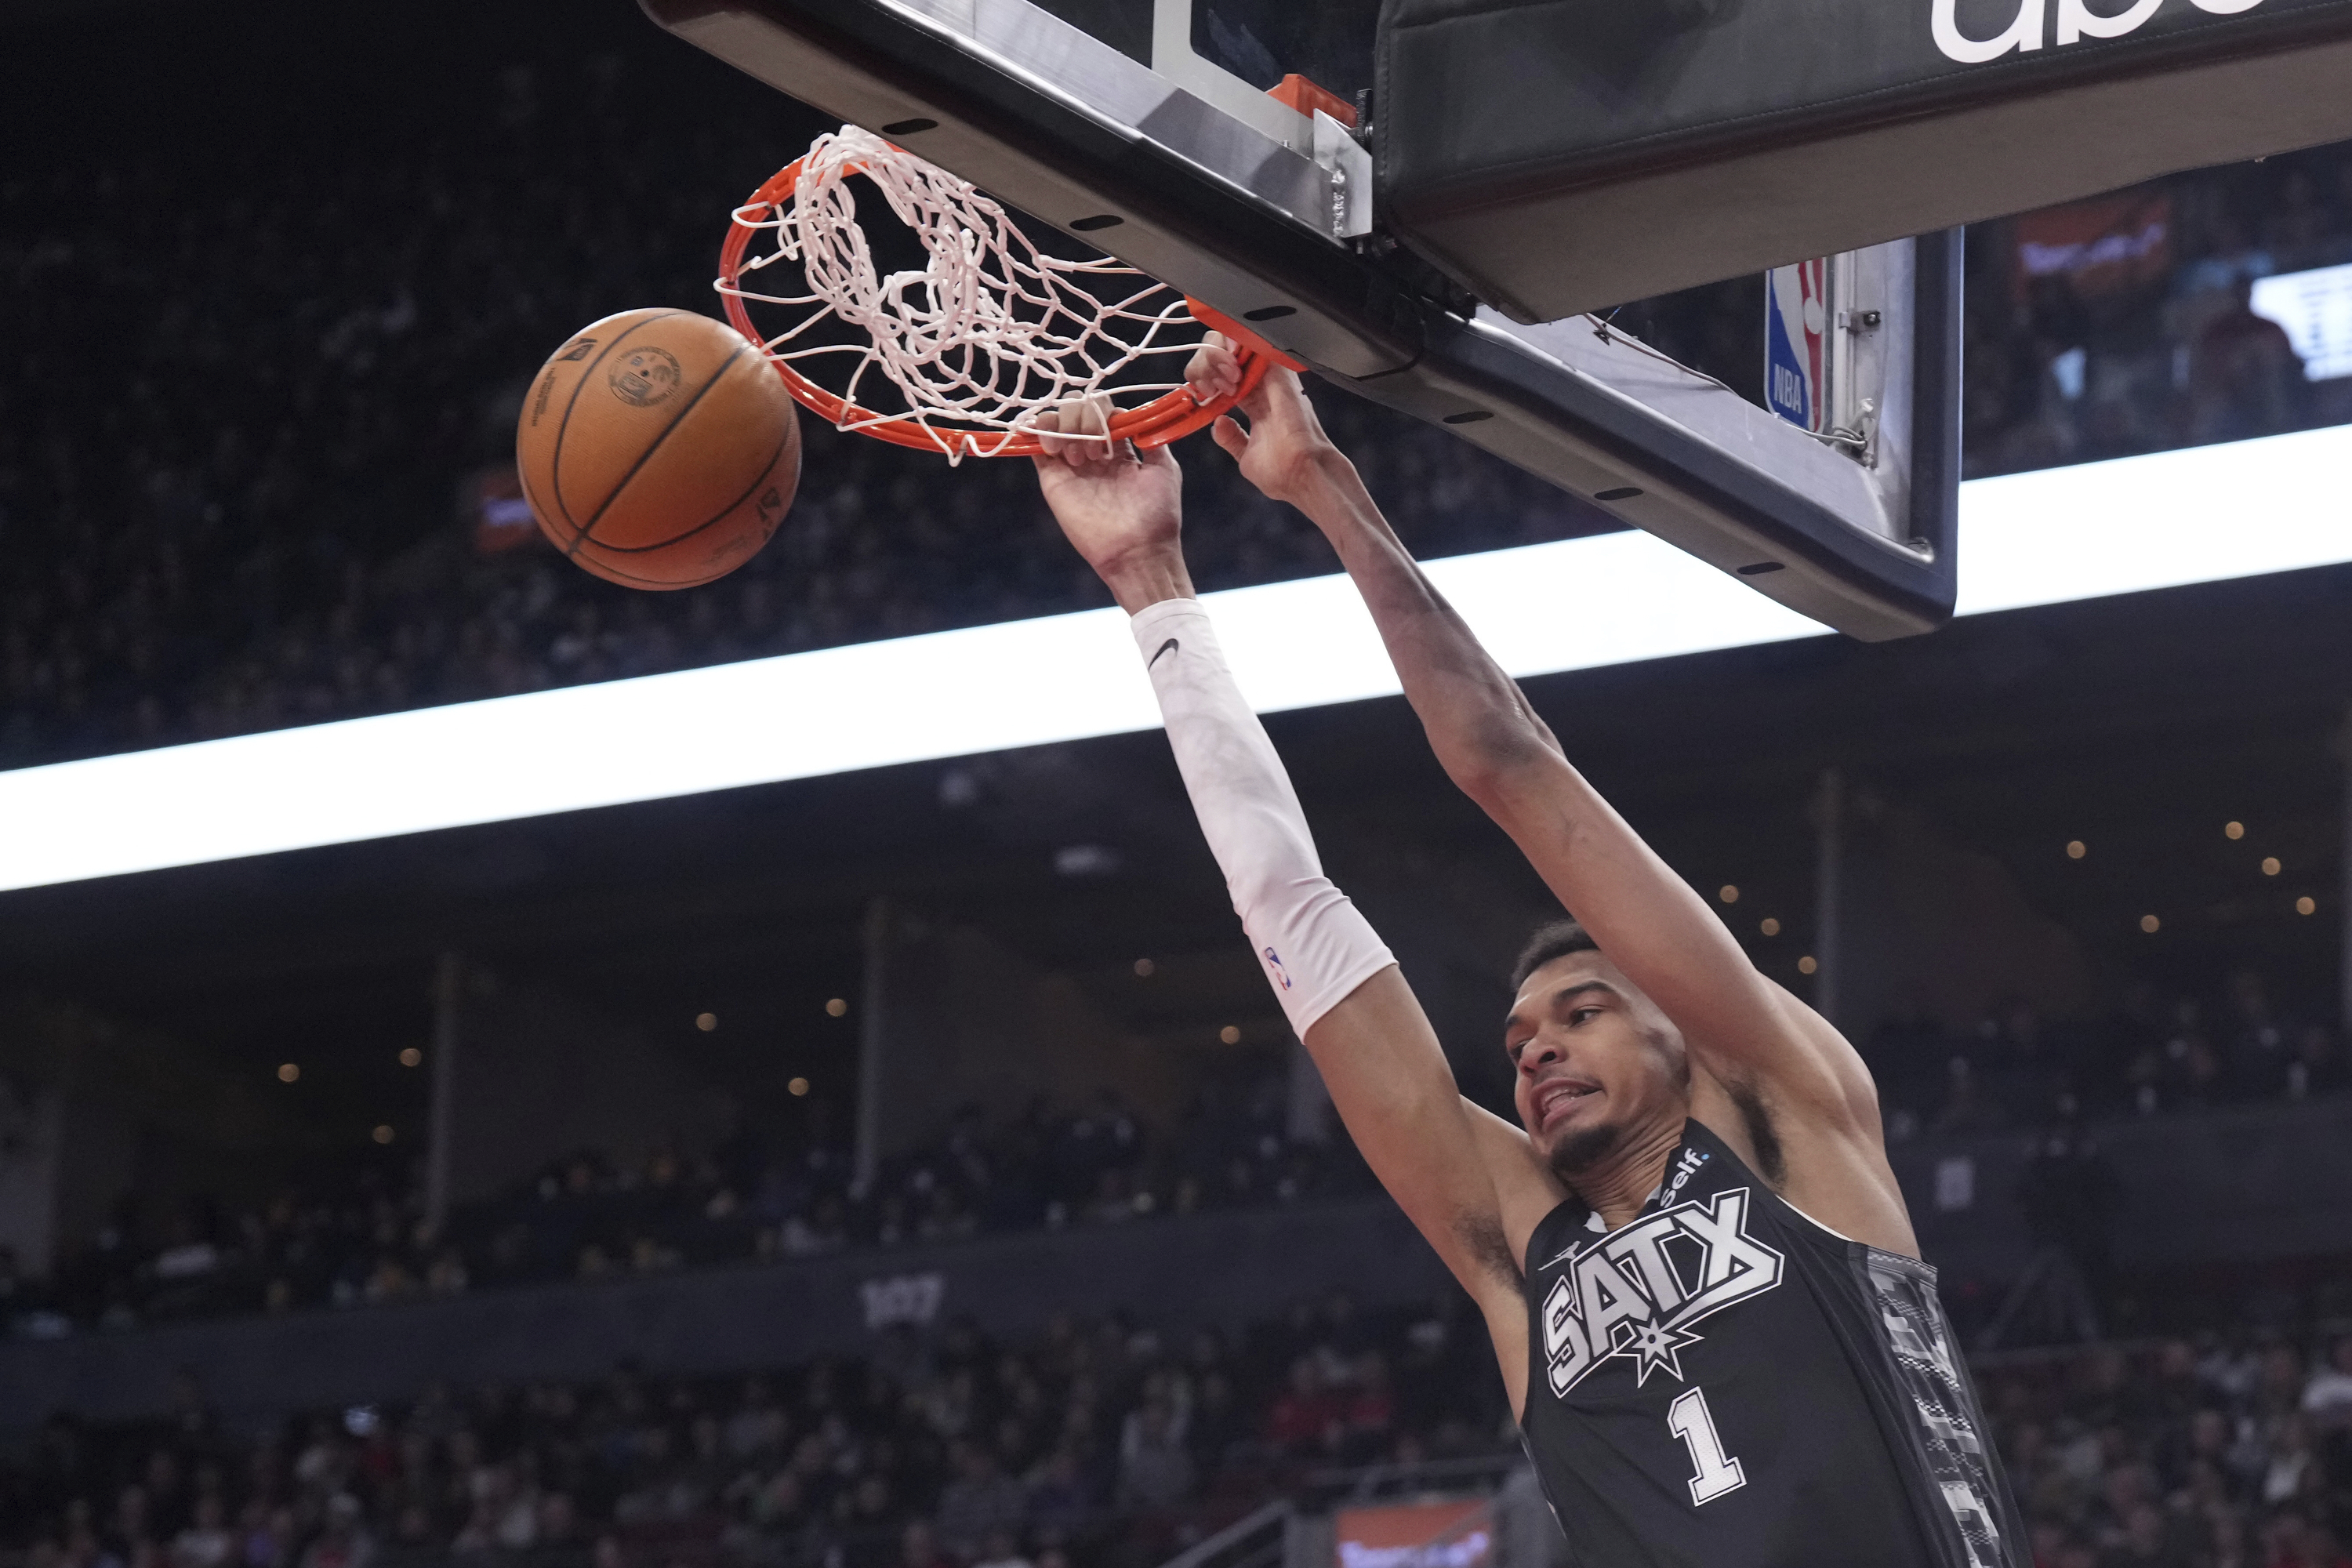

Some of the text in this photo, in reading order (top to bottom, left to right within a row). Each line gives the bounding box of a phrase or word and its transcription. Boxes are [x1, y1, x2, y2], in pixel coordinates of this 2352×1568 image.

[1773, 363, 1802, 414] NBA
[1541, 1186, 1785, 1399] SATX
[1667, 1386, 1748, 1507] 1
